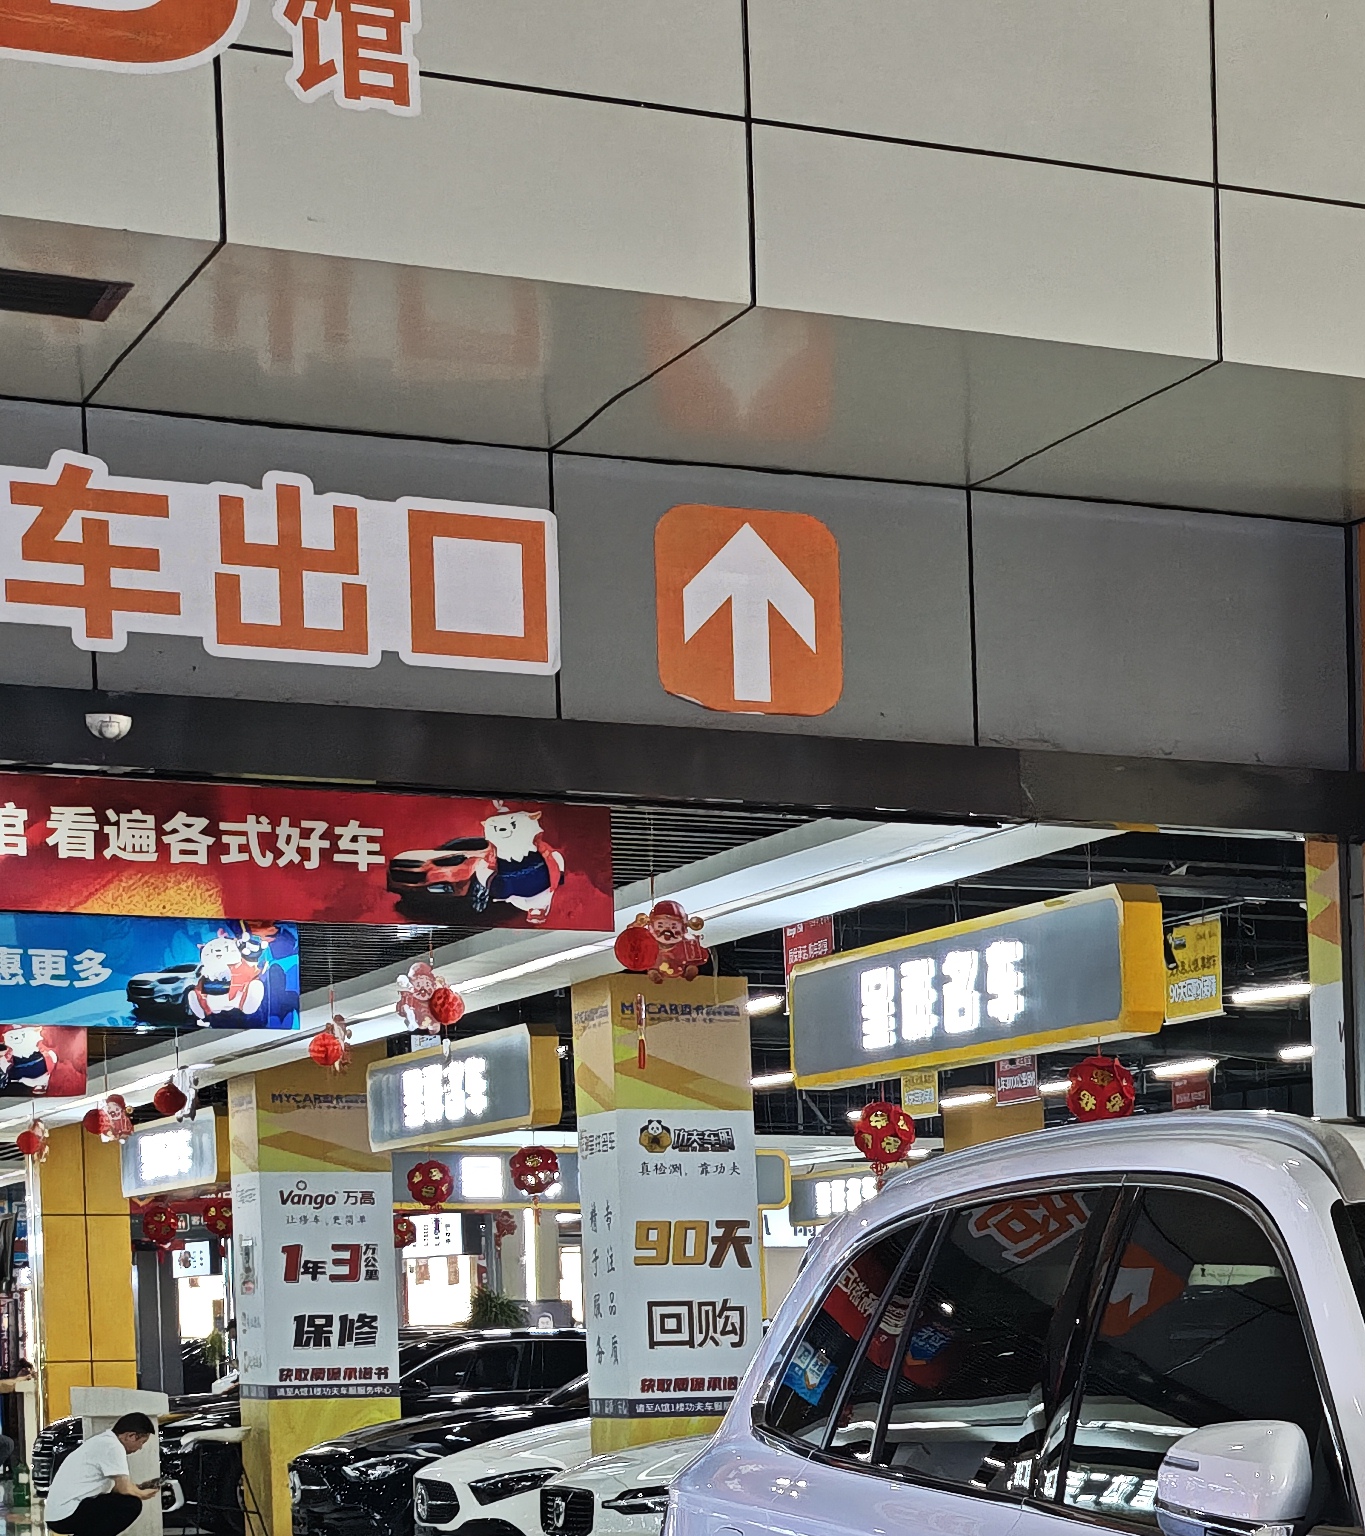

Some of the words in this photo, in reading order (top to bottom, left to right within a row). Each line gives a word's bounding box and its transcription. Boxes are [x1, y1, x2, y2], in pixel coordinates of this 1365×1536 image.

[4, 462, 552, 664] 车出口
[45, 806, 386, 872] 看遍各式好车
[279, 1188, 337, 1210] Vango
[343, 1190, 375, 1206] 万高
[633, 1218, 753, 1269] 90天
[292, 1313, 379, 1350] 保修
[646, 1298, 749, 1350] 回购
